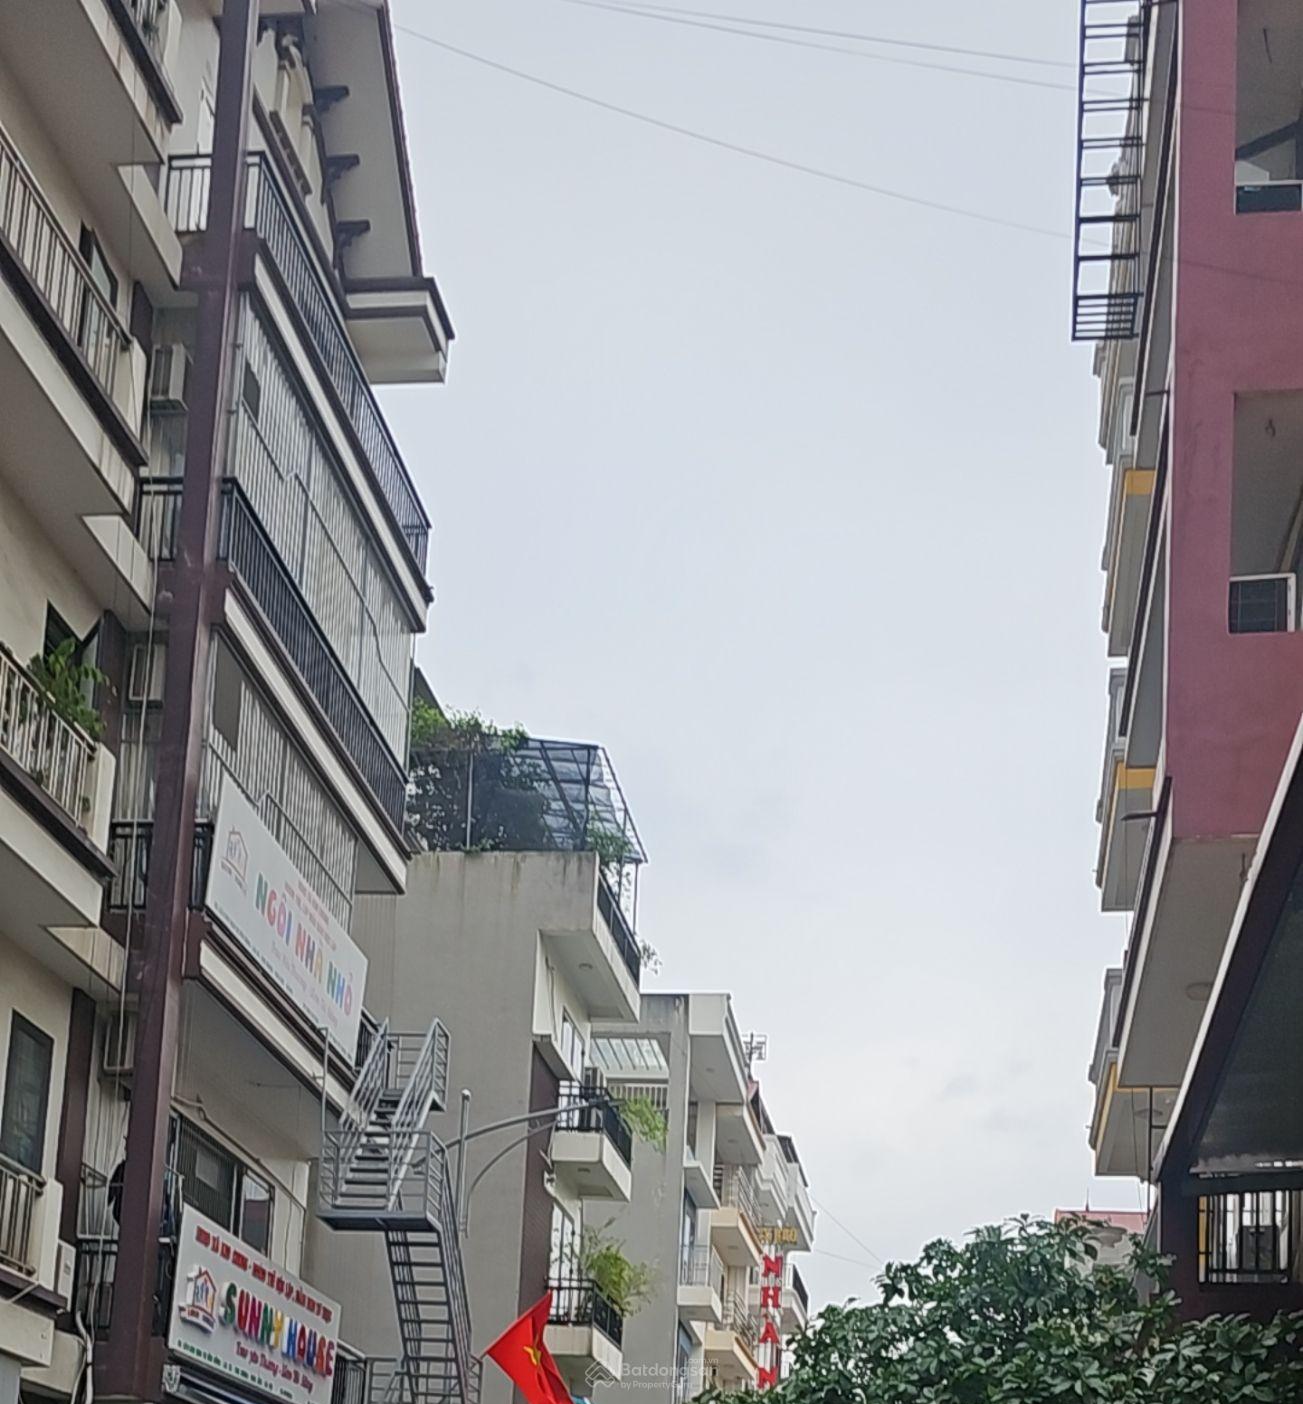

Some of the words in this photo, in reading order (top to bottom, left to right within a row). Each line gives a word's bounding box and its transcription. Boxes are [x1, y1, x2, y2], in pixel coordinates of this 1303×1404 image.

[254, 871, 292, 946] NGÔI
[326, 960, 354, 1016] NHỎ
[222, 1282, 284, 1350] SUNNY
[285, 1316, 335, 1378] HOUSE
